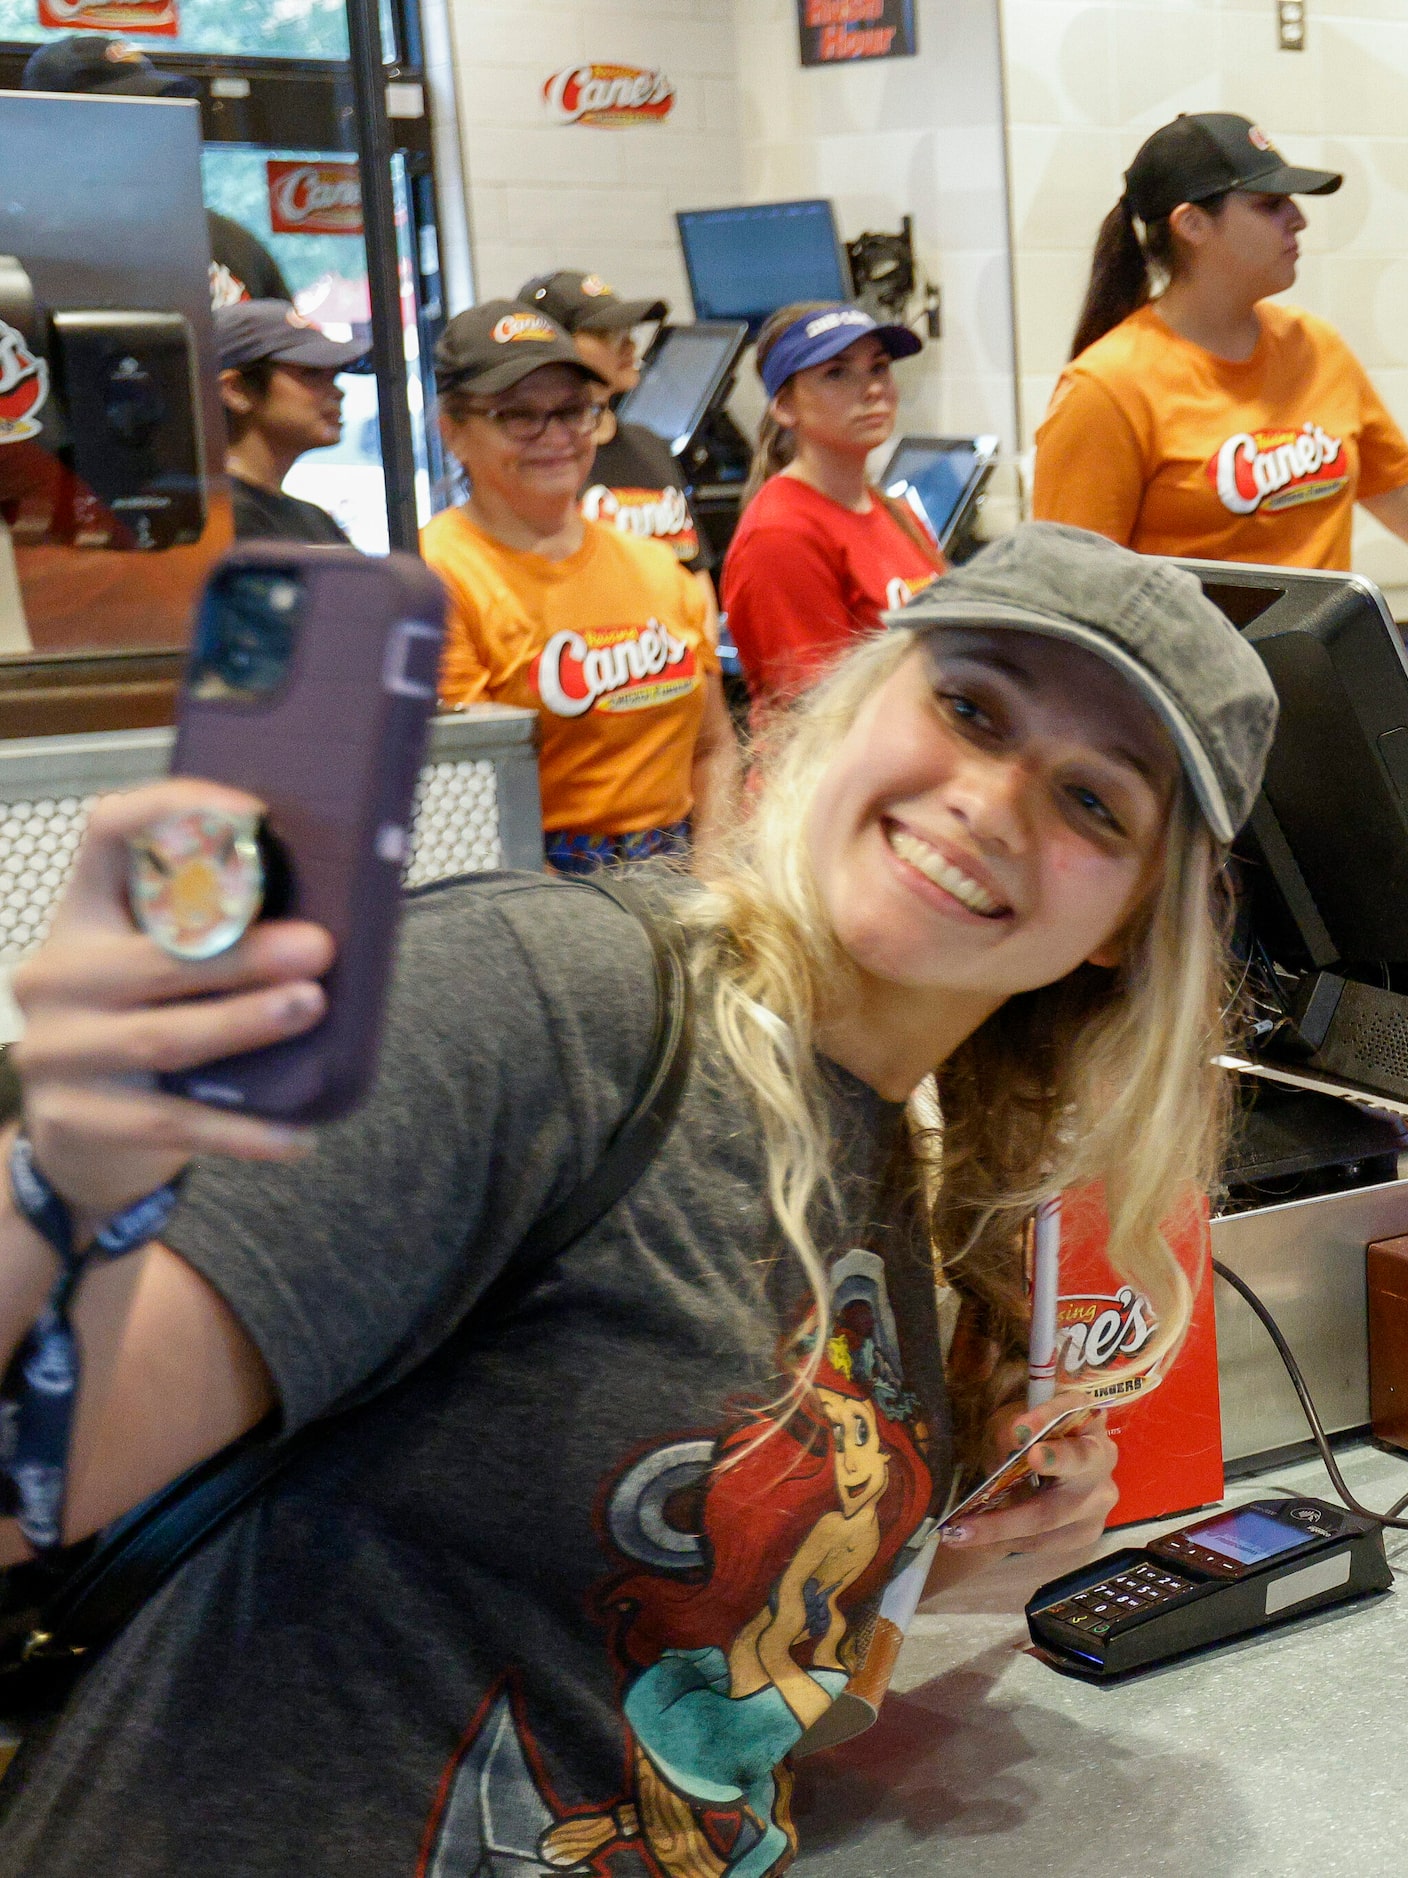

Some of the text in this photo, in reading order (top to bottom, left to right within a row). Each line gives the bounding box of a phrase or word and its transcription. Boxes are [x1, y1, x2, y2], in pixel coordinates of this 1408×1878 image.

[1216, 421, 1342, 514] Cane's
[537, 616, 688, 717] Cane's
[1057, 1288, 1160, 1373] ne's
[1058, 1303, 1097, 1322] sing
[1093, 1377, 1144, 1398] INGERS
